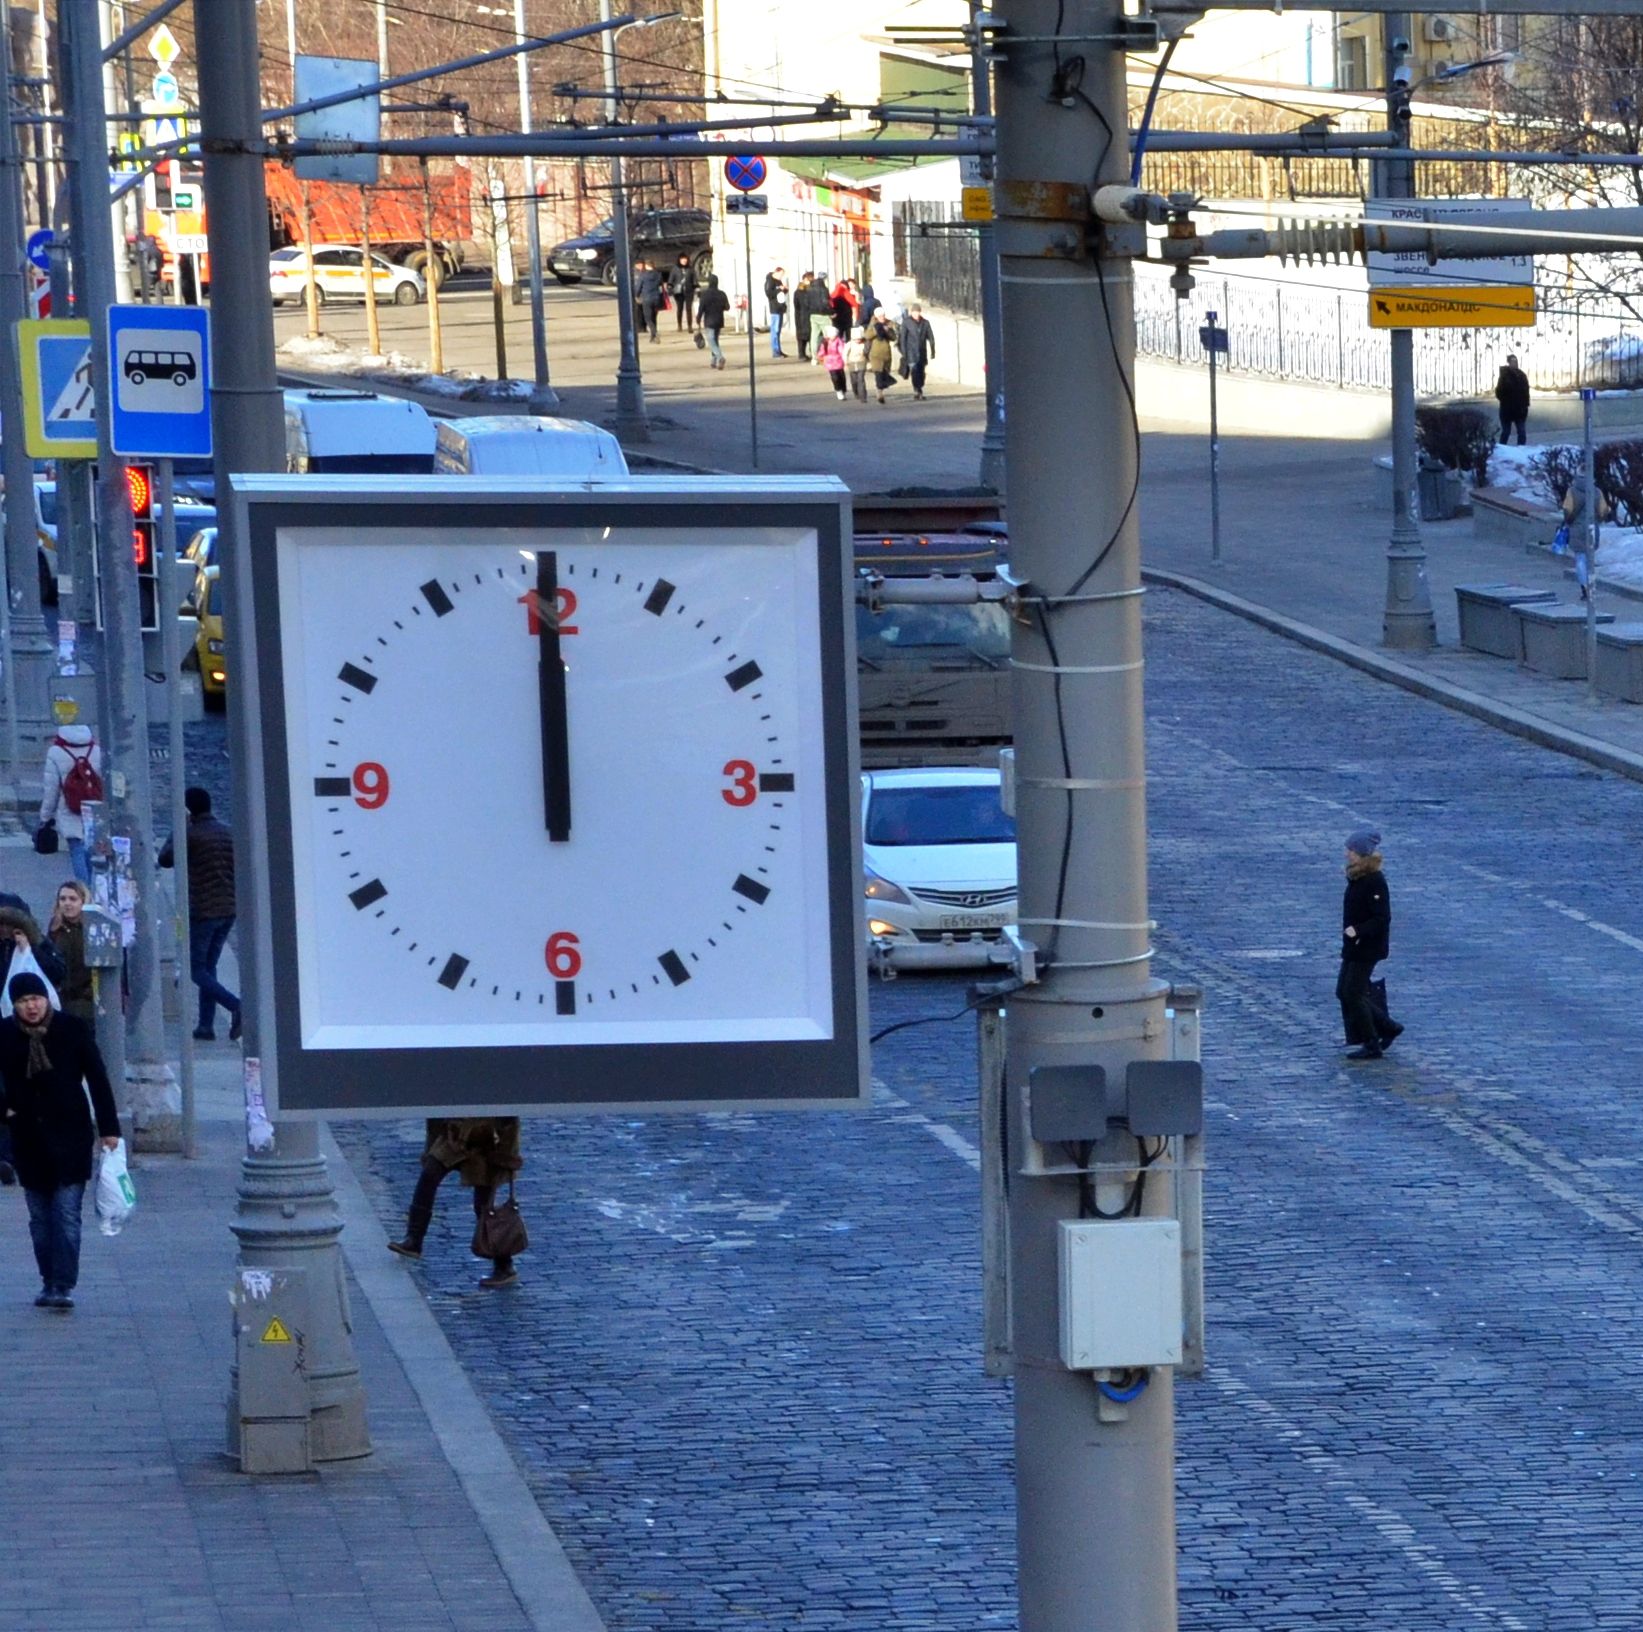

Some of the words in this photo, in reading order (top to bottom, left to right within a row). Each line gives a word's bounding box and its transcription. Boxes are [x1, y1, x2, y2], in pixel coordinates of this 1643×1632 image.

[517, 587, 578, 636] 12
[352, 761, 390, 810] 9
[721, 759, 758, 807] 3
[544, 931, 583, 979] 6
